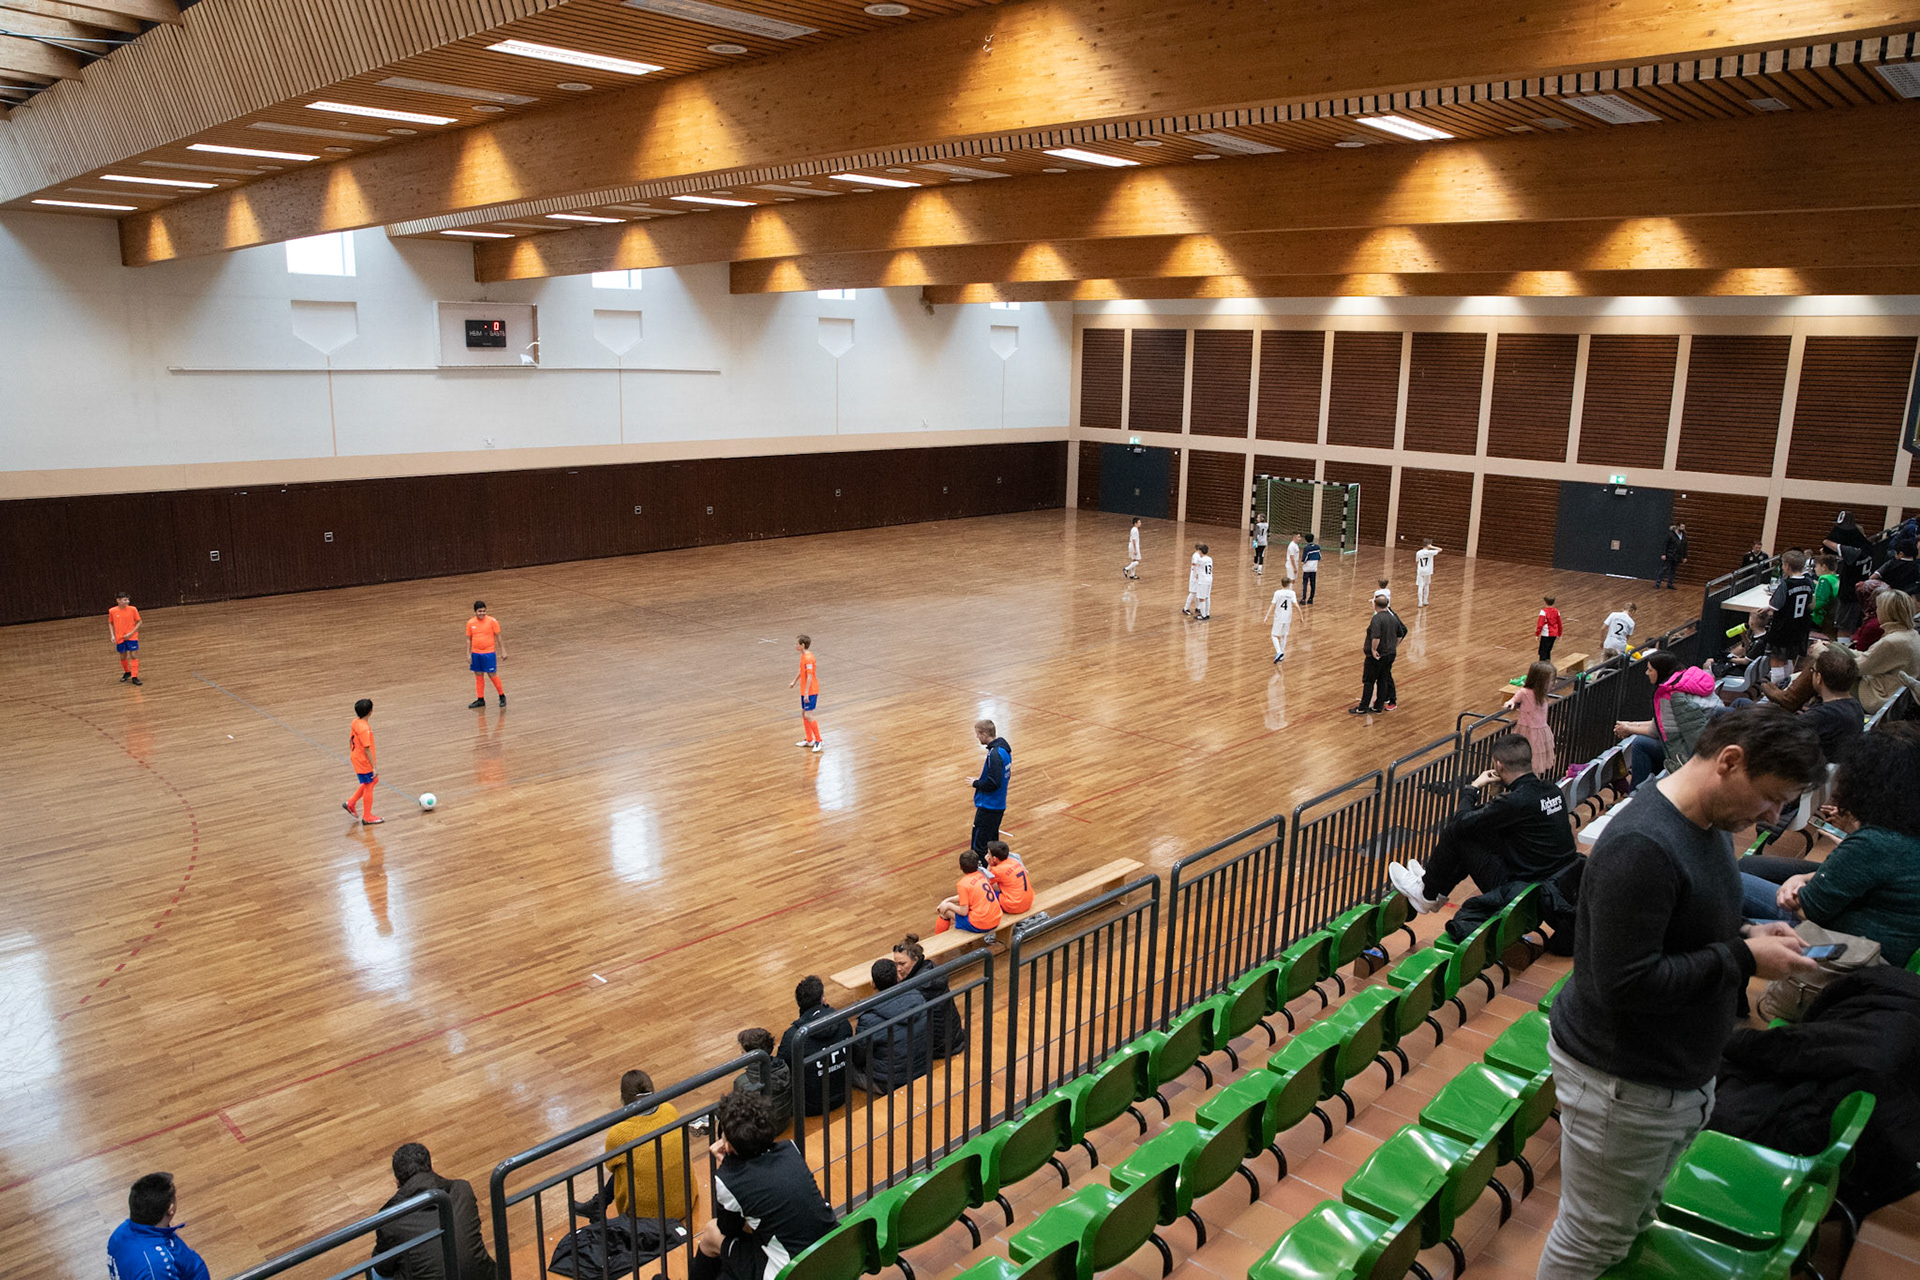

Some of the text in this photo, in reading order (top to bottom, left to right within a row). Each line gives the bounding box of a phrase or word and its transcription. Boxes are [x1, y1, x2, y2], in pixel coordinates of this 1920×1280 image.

[493, 321, 500, 331] 0
[1419, 557, 1429, 567] 17
[1280, 599, 1288, 611] 4
[1793, 594, 1808, 619] 8
[1614, 623, 1624, 636] 2
[1540, 795, 1562, 812] Kickers
[1016, 870, 1028, 892] 7
[982, 883, 995, 902] 8
